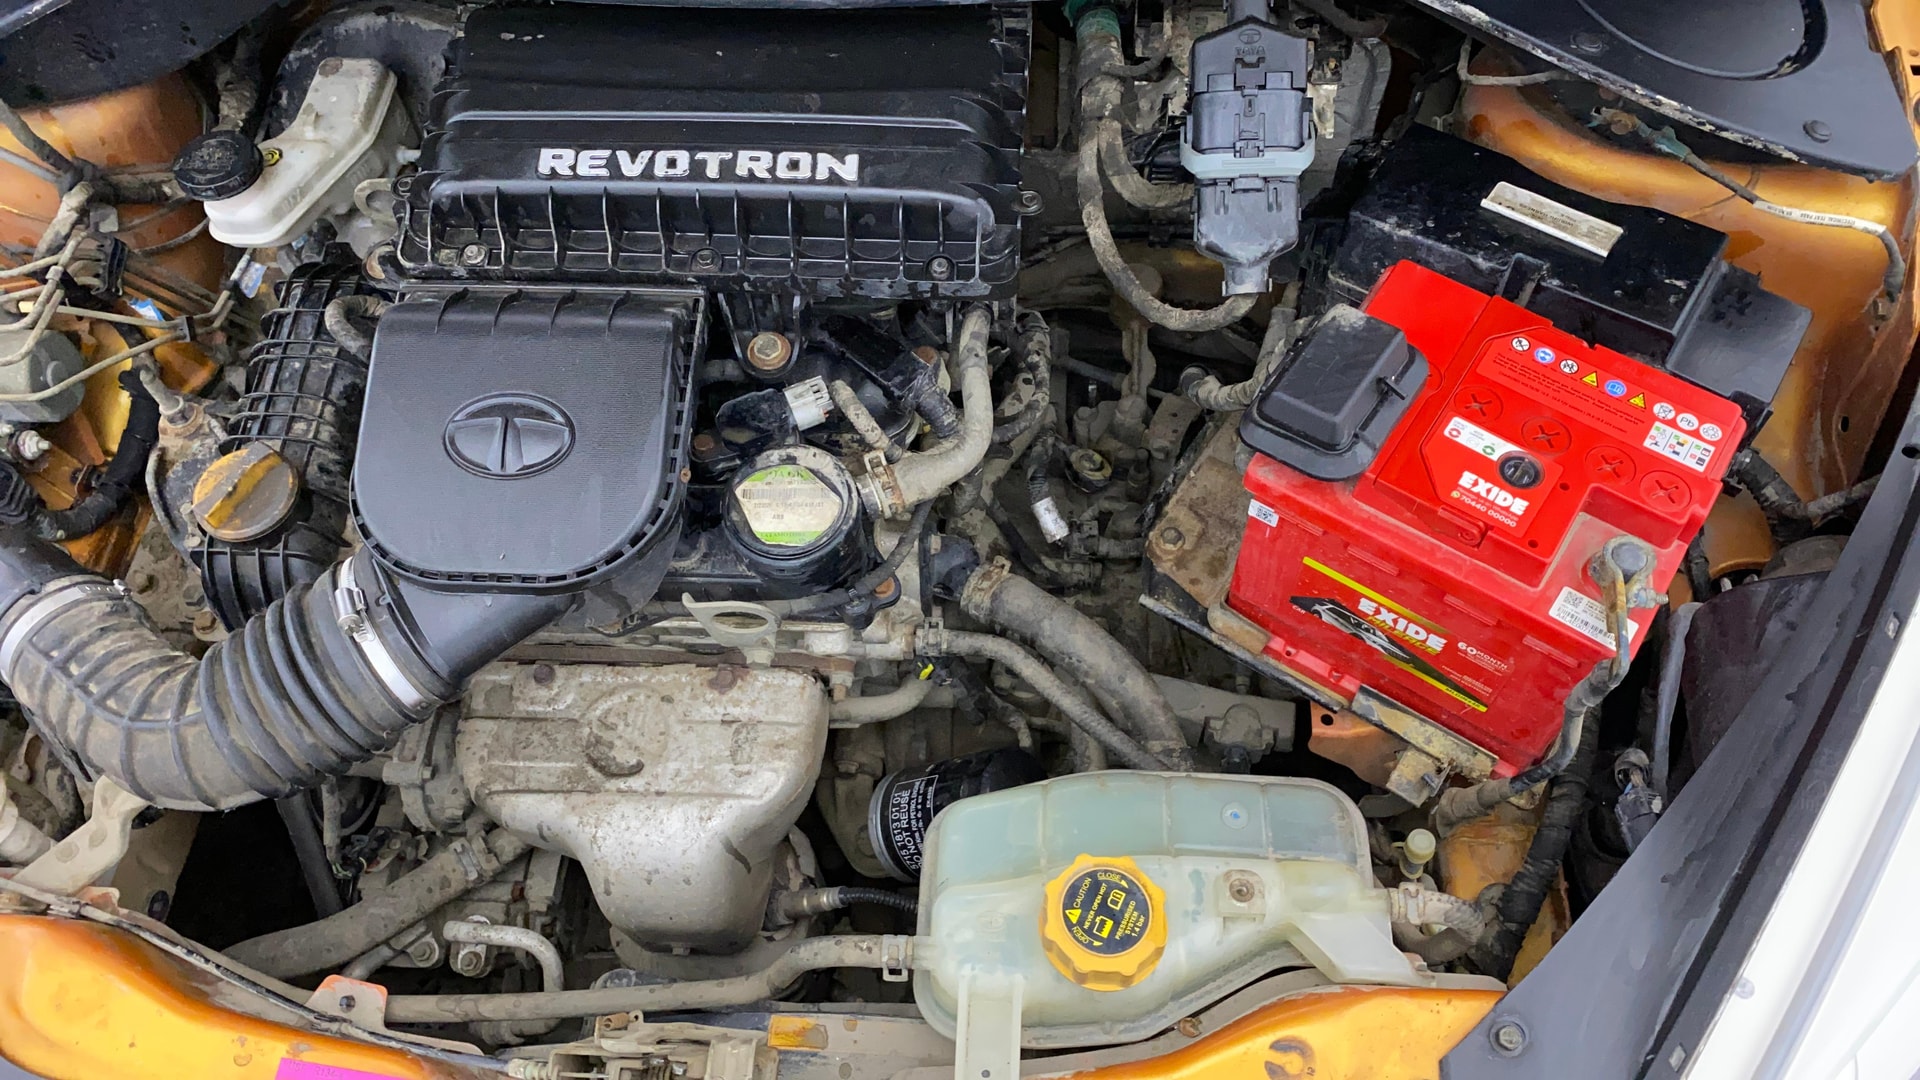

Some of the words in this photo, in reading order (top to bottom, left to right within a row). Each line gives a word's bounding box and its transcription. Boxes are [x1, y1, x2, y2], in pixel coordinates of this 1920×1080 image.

[538, 148, 860, 182] REVOTRON
[1680, 416, 1695, 428] Pb
[1458, 470, 1530, 516] EXIDE
[1460, 495, 1488, 512] 70440
[1487, 509, 1517, 528] 00000
[1357, 597, 1448, 653] EXIDE
[1367, 615, 1442, 656] MILEAGE
[1457, 641, 1477, 655] 60
[1476, 650, 1508, 671] MONTH
[892, 792, 902, 804] 01
[900, 789, 911, 828] REUSE
[891, 807, 900, 820] 01
[892, 821, 905, 847] 1813
[902, 830, 918, 853] NOT
[1097, 872, 1122, 881] CLOSE
[1073, 877, 1093, 908] CAUTION
[1083, 909, 1096, 929] NEVER
[1091, 894, 1103, 911] OPEN
[1099, 882, 1108, 897] HOT
[1072, 925, 1089, 944] OPEN
[1114, 900, 1136, 940] PRESSURISED
[1124, 910, 1139, 935] SYSTEM
[1136, 914, 1146, 927] bar
